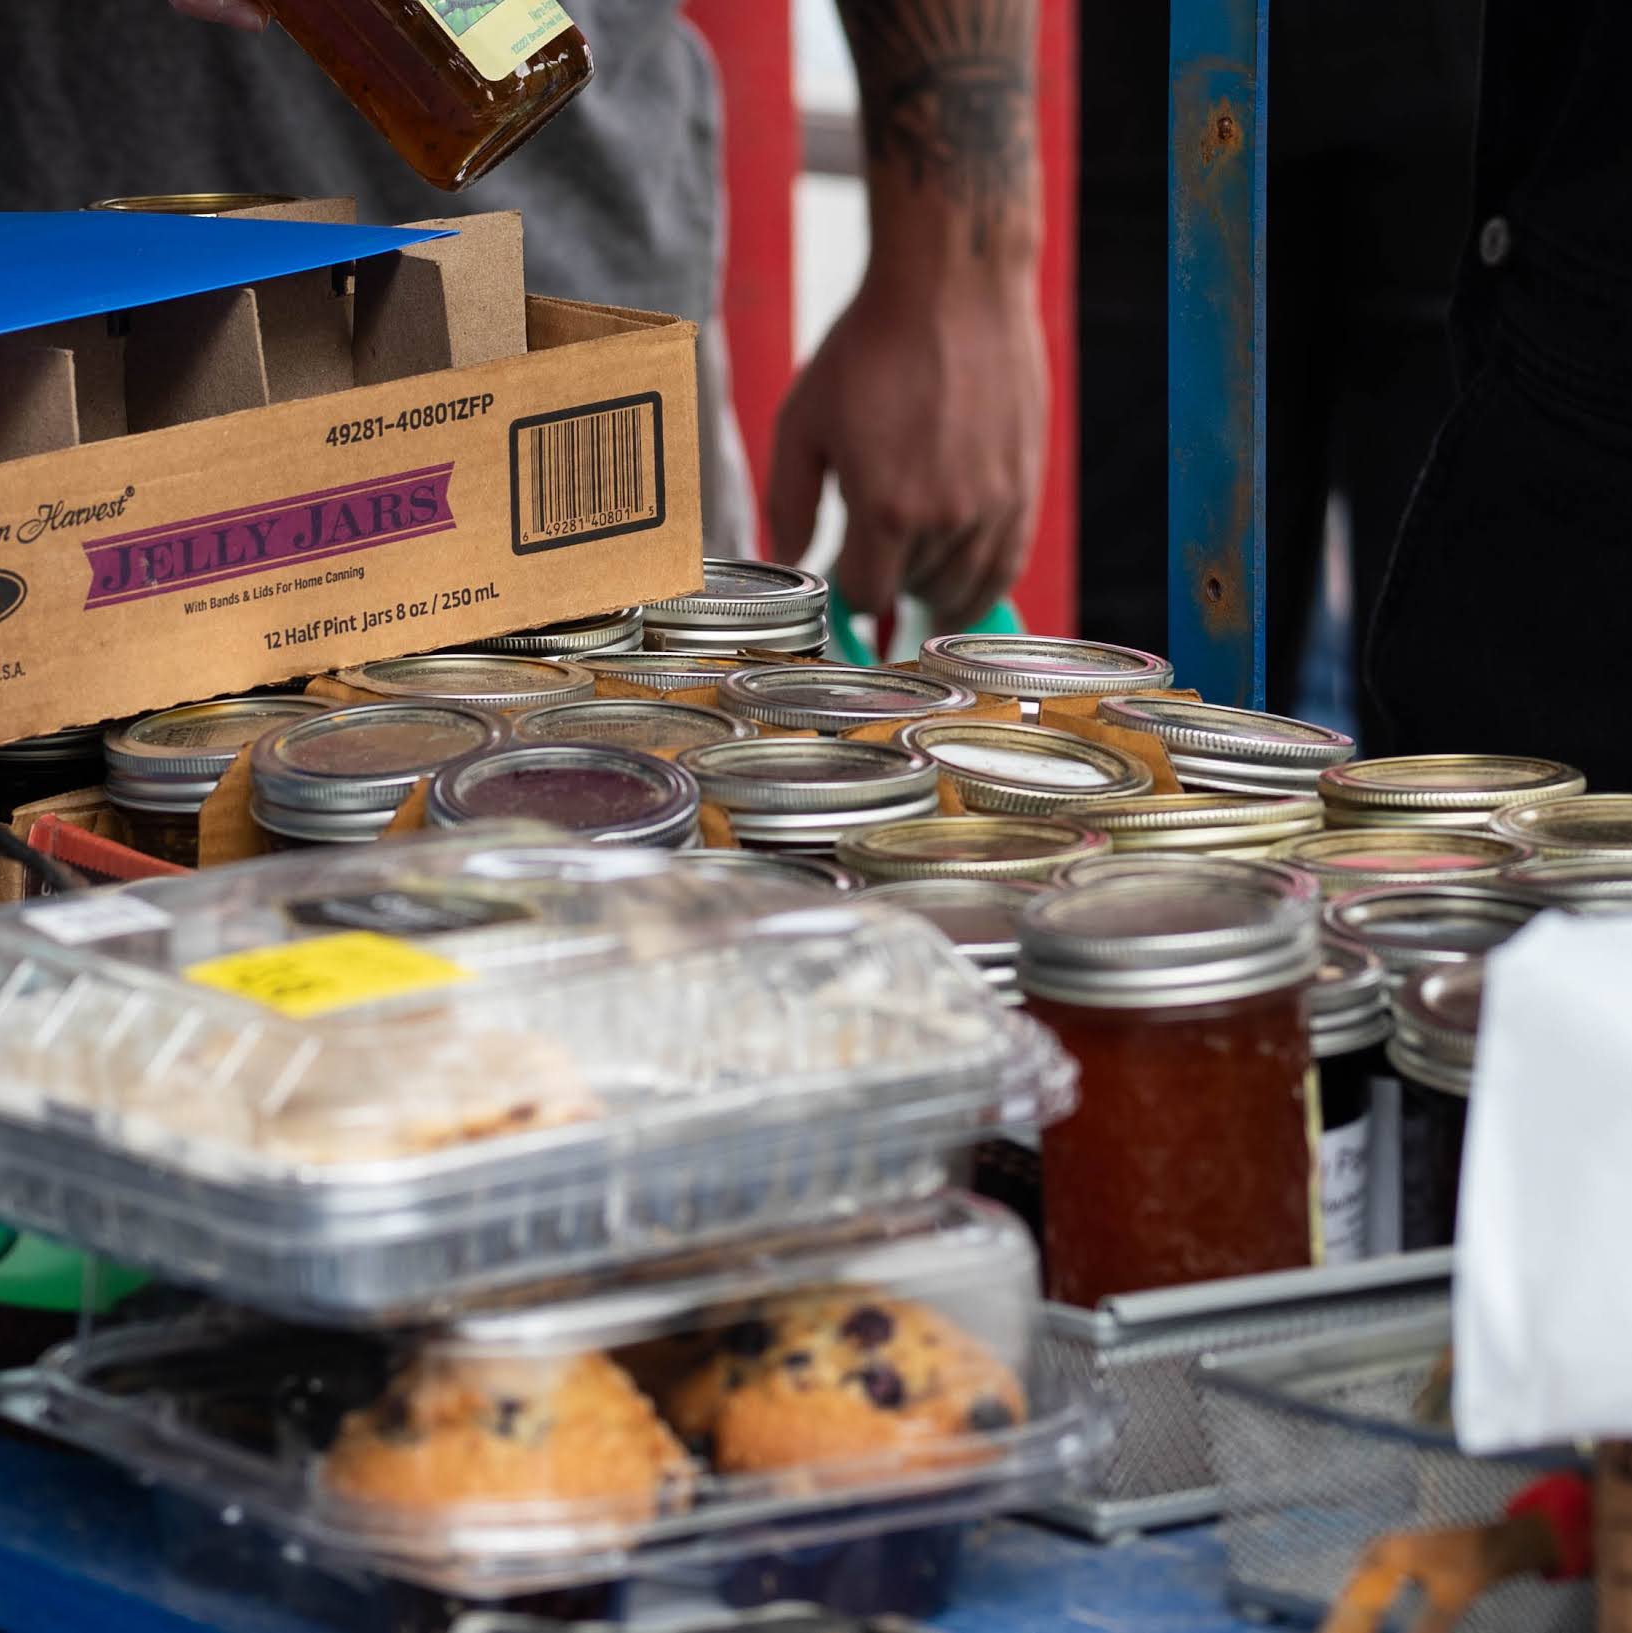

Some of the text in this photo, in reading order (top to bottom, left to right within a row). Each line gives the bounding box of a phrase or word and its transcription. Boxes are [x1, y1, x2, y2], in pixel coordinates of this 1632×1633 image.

[326, 392, 494, 447] 49281-40801ZFP
[102, 484, 439, 592] JELLY JARS
[545, 517, 585, 537] 49281
[591, 506, 632, 528] 40801
[184, 565, 365, 615] With Bands & Lids For Home Canning
[264, 632, 282, 650] 12
[285, 623, 321, 648] Half
[323, 615, 357, 639] Pint
[362, 608, 394, 633] Jars
[396, 604, 407, 620] 8
[409, 601, 428, 618] oz
[442, 587, 472, 611] 250
[474, 582, 500, 604] mL
